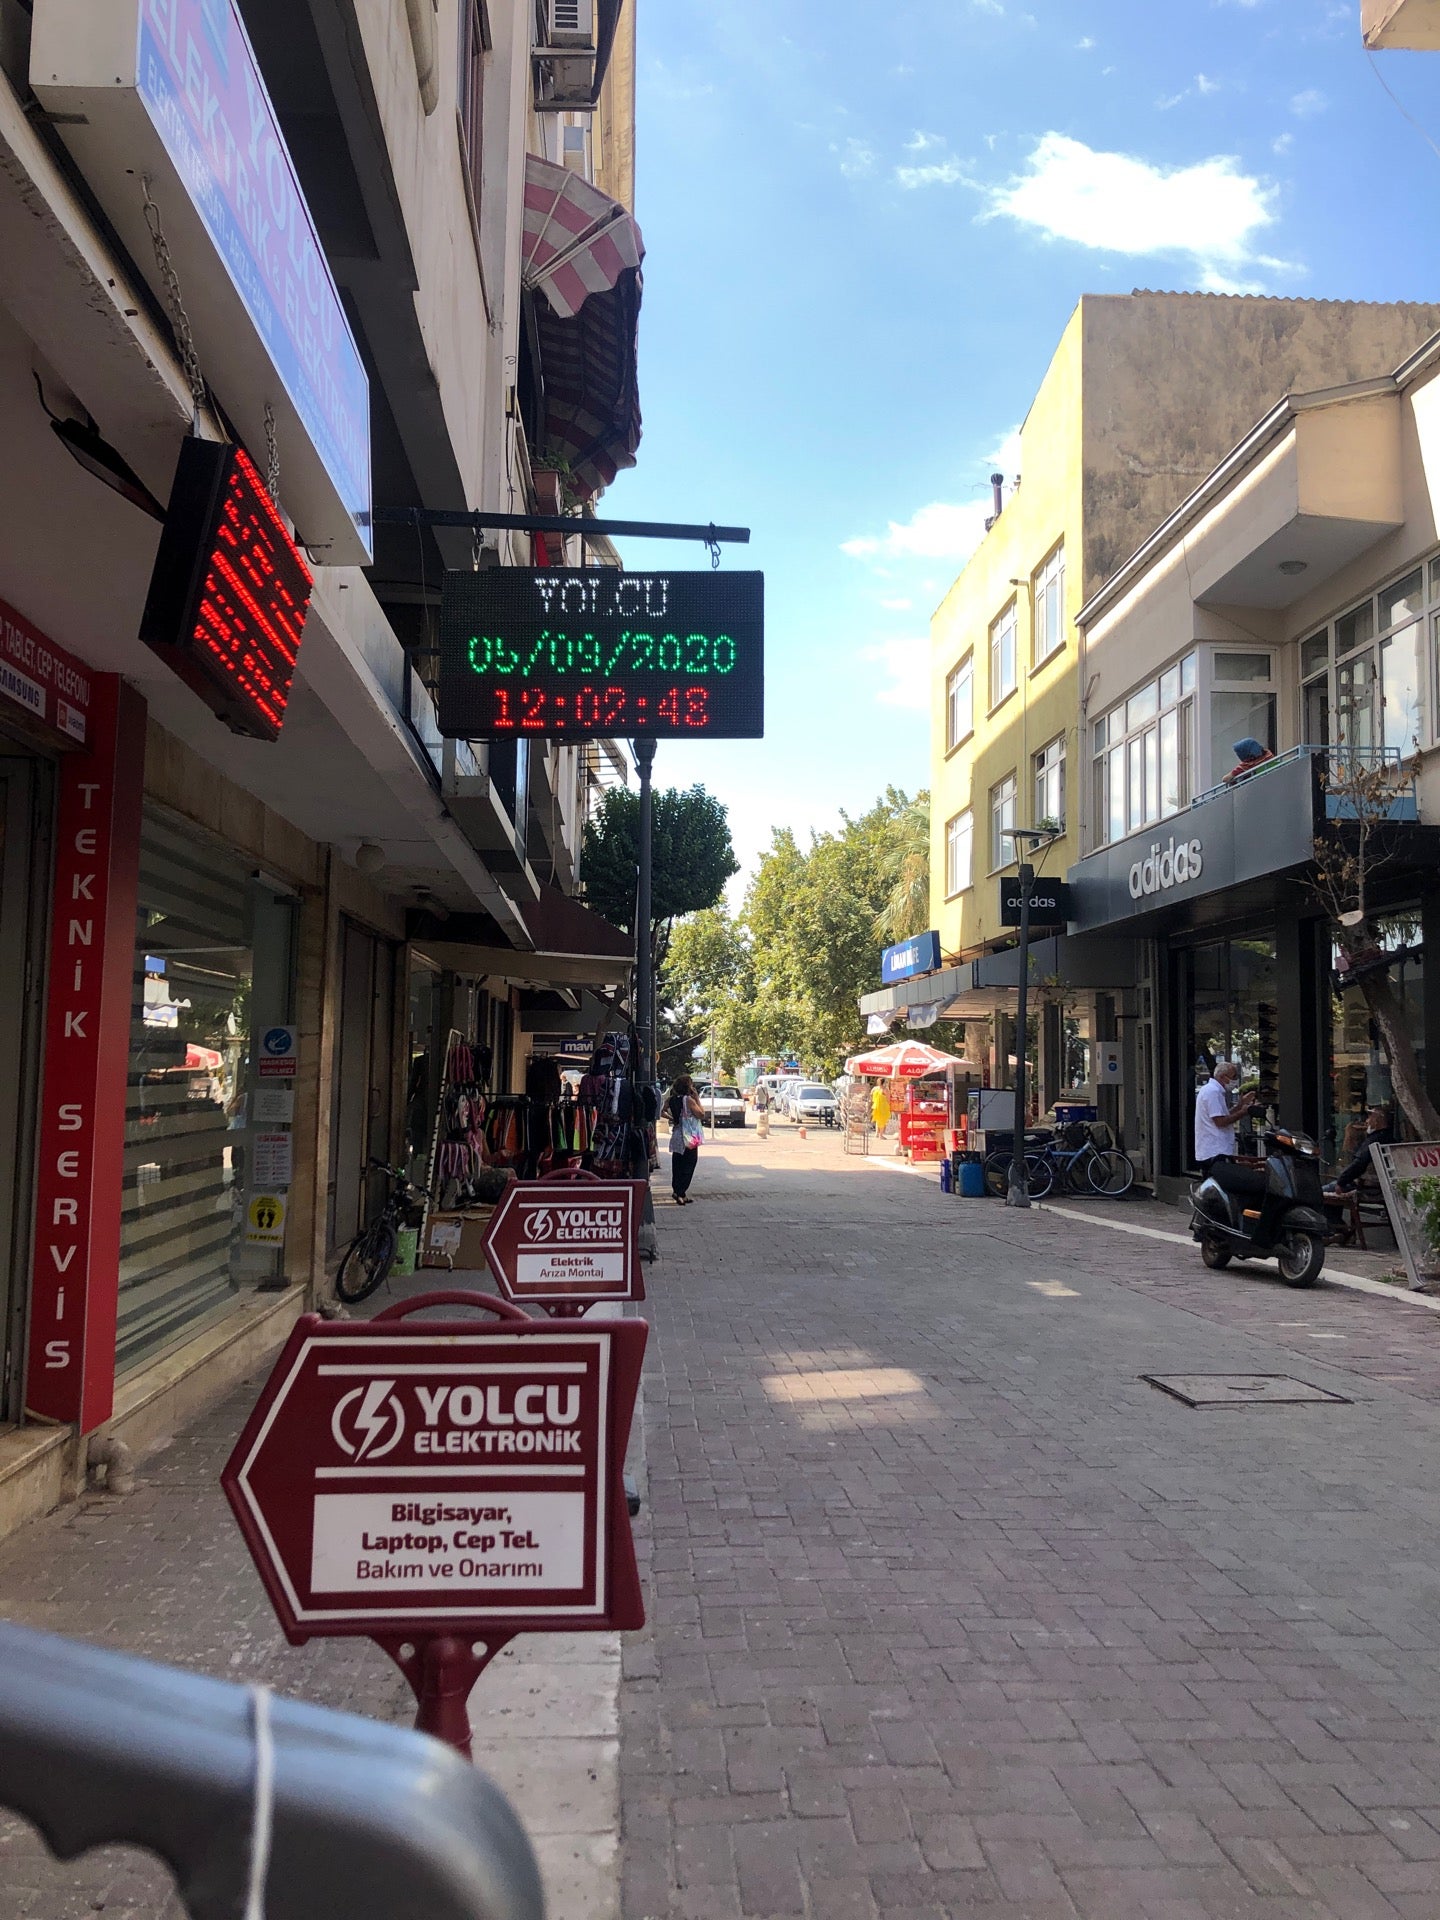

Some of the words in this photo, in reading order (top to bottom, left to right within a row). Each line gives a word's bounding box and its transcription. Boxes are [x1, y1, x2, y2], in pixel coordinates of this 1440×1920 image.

[243, 60, 333, 352] YOLCU
[534, 578, 669, 617] YOLCU
[494, 687, 709, 727] 12:02:48
[1128, 836, 1203, 899] adidas
[1007, 895, 1056, 908] addas
[564, 1040, 593, 1052] mavi
[556, 1210, 622, 1227] YOLCU
[540, 1268, 566, 1278] Arıza
[568, 1267, 604, 1279] Montaj
[550, 1256, 594, 1267] Elektrik
[414, 1385, 581, 1426] YOLCU
[391, 1502, 512, 1526] Bilgisayar,
[362, 1532, 449, 1554] Laptop,
[453, 1530, 496, 1552] Cep
[356, 1560, 424, 1579] Bakım
[428, 1563, 454, 1577] ve
[459, 1558, 543, 1578] Onarımı
